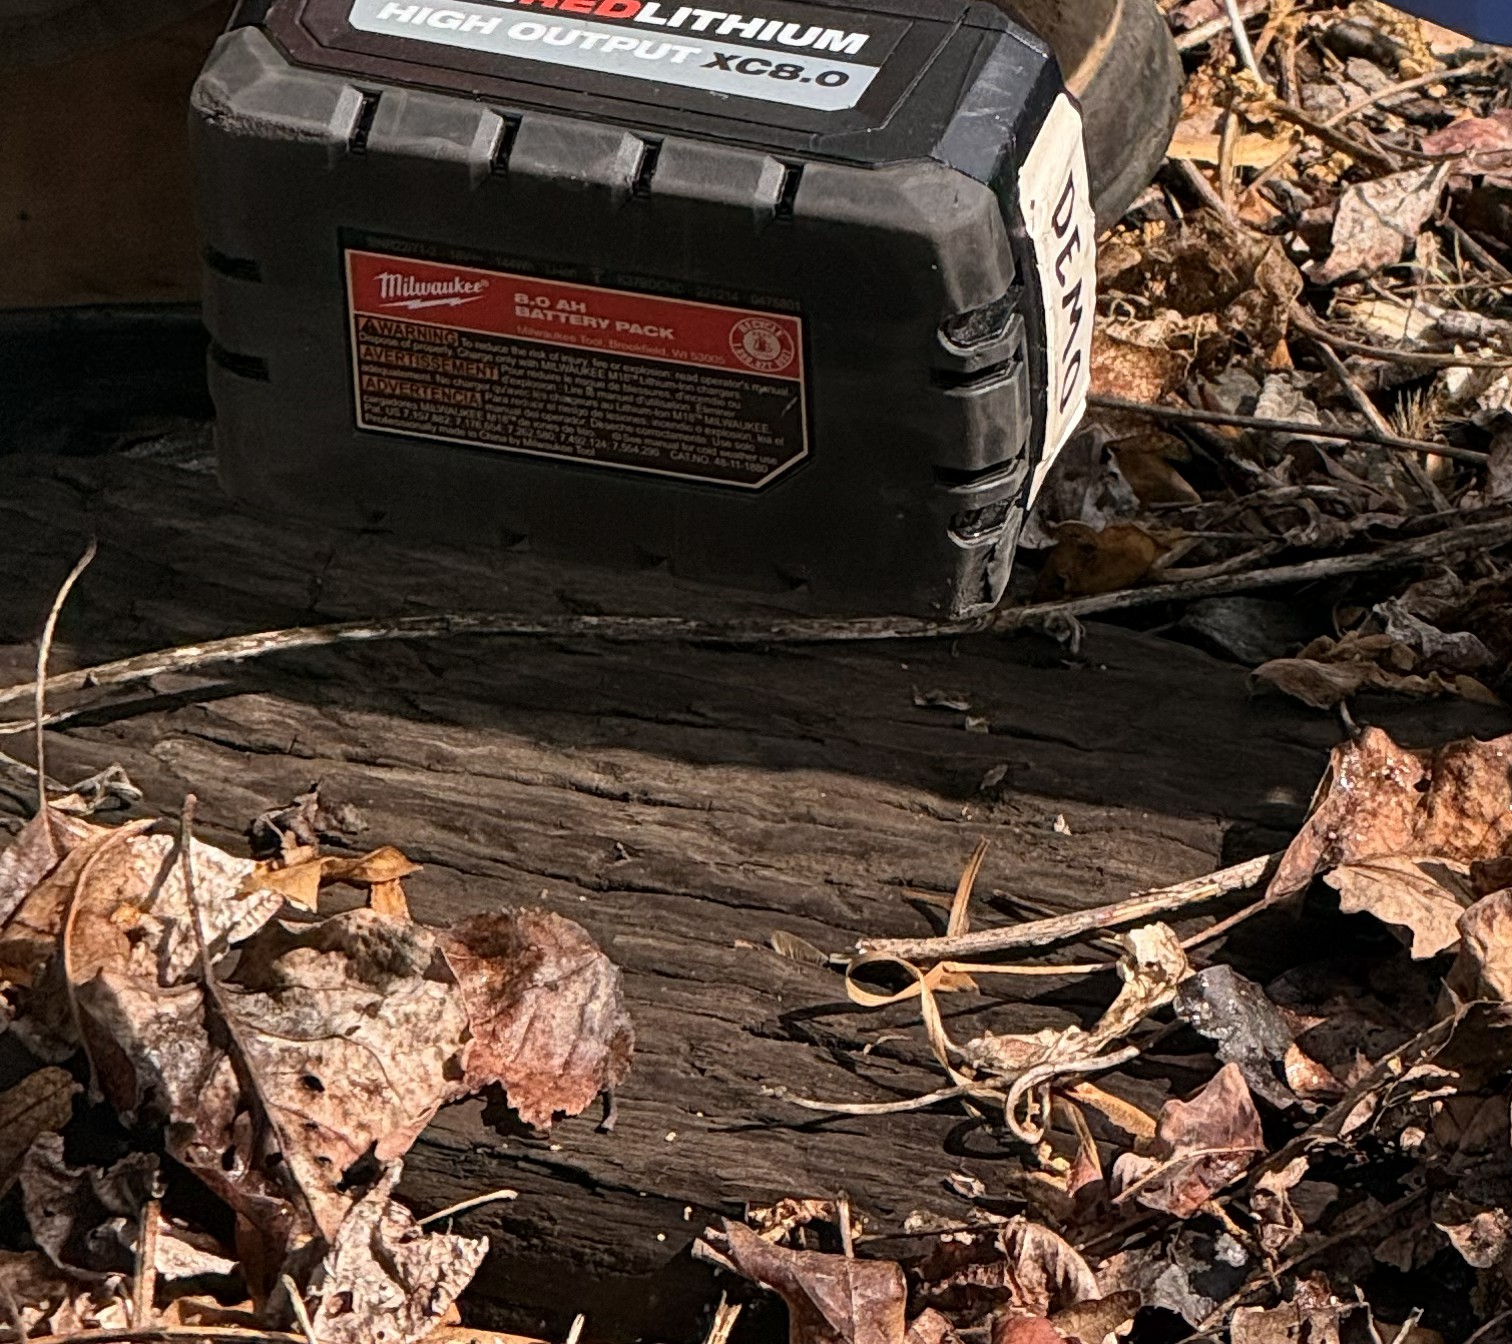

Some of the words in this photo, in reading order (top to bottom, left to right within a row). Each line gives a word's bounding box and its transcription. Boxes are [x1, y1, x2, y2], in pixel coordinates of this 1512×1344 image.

[376, 1, 503, 36] HIGH
[507, 21, 703, 64] OUTPUT
[700, 51, 850, 88] XC8.0
[372, 271, 485, 299] Milwaukee
[1052, 169, 1084, 415] DEMO
[513, 291, 552, 309] 8.0
[554, 297, 587, 314] AH
[377, 319, 457, 346] WARNING
[514, 304, 611, 331] BATTERY
[614, 319, 676, 341] PACK
[516, 324, 577, 343] Milwaukee
[362, 345, 496, 379] AVERTISSEMENT
[364, 376, 479, 406] ADVERTENCIA
